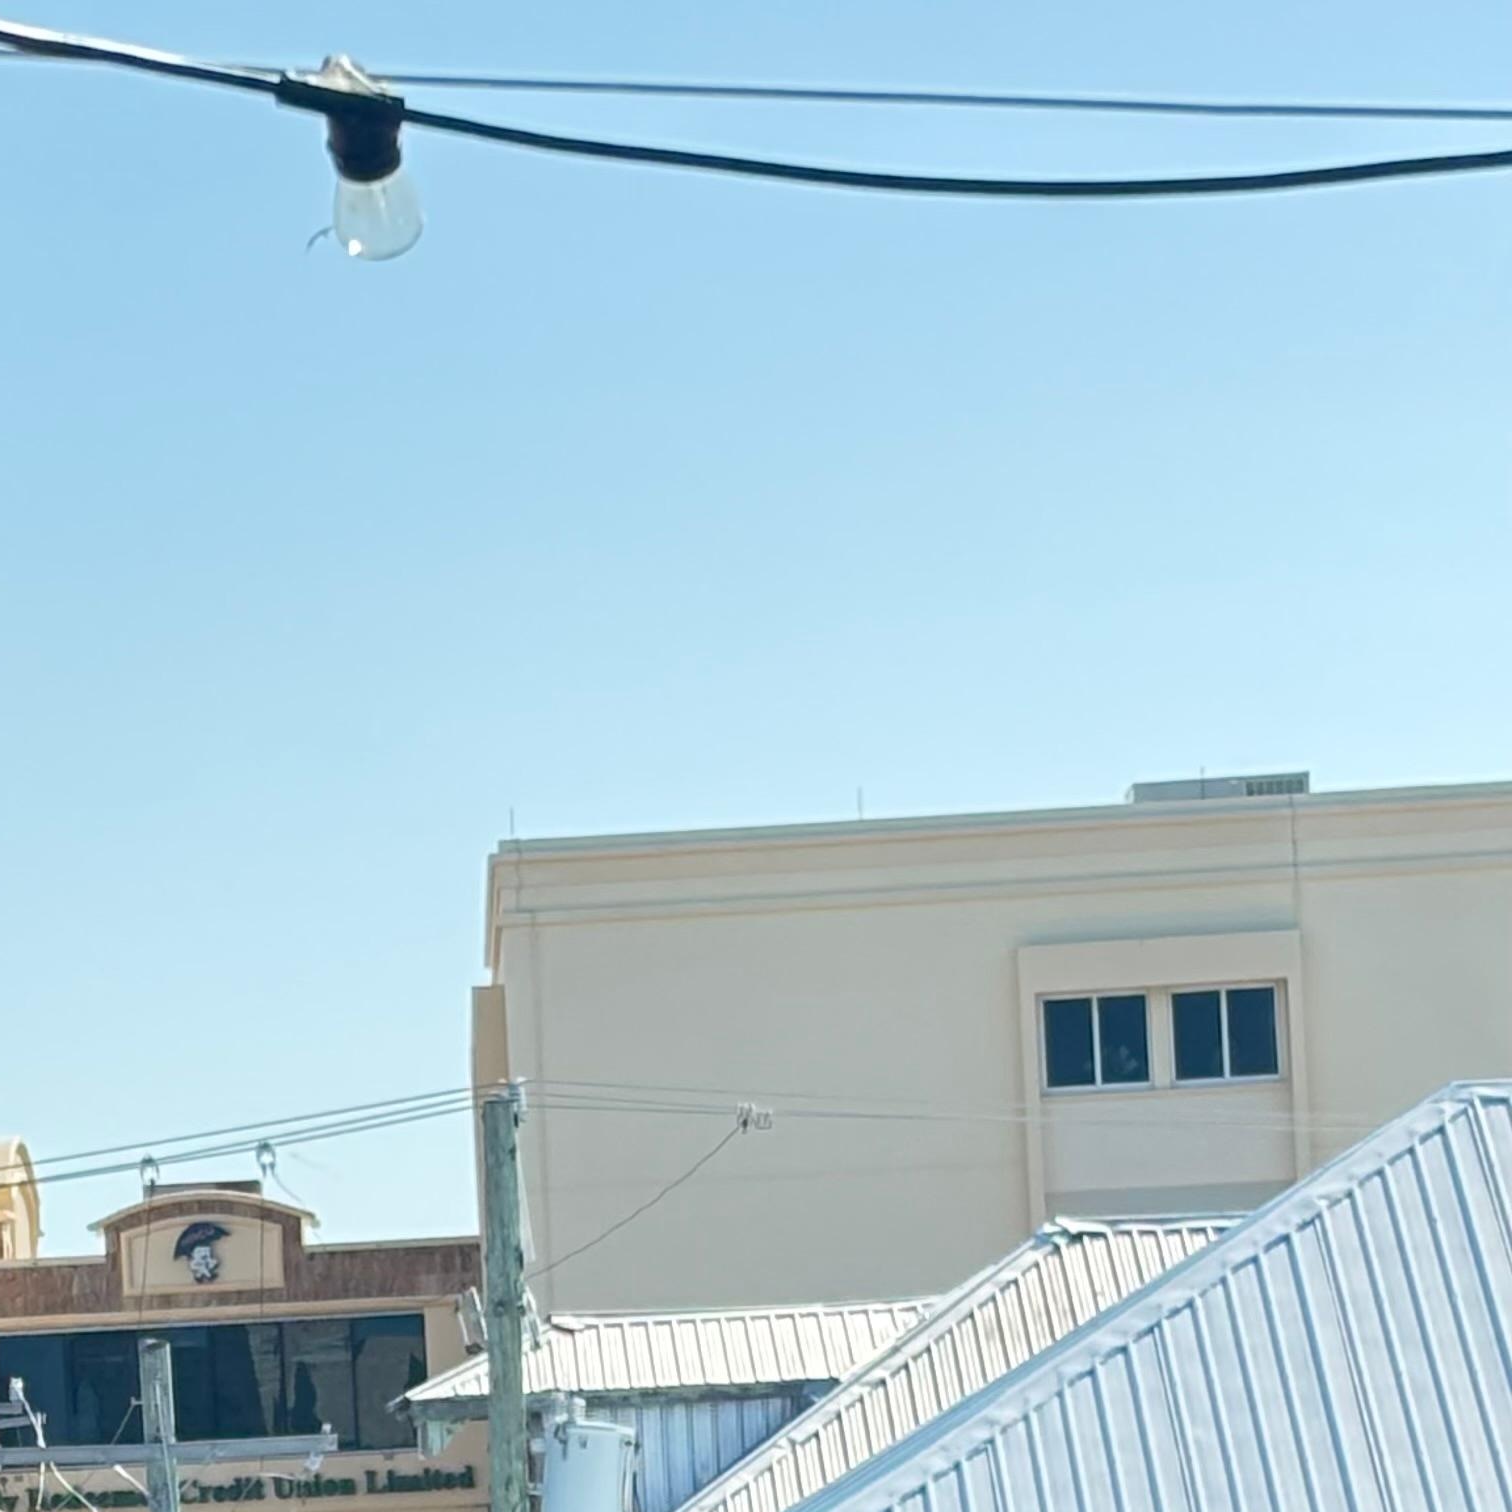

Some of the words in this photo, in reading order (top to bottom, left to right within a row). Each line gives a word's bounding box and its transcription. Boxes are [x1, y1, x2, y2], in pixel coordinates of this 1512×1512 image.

[179, 1475, 265, 1504] Credit
[272, 1473, 357, 1500] Union
[365, 1464, 476, 1494] Limited
